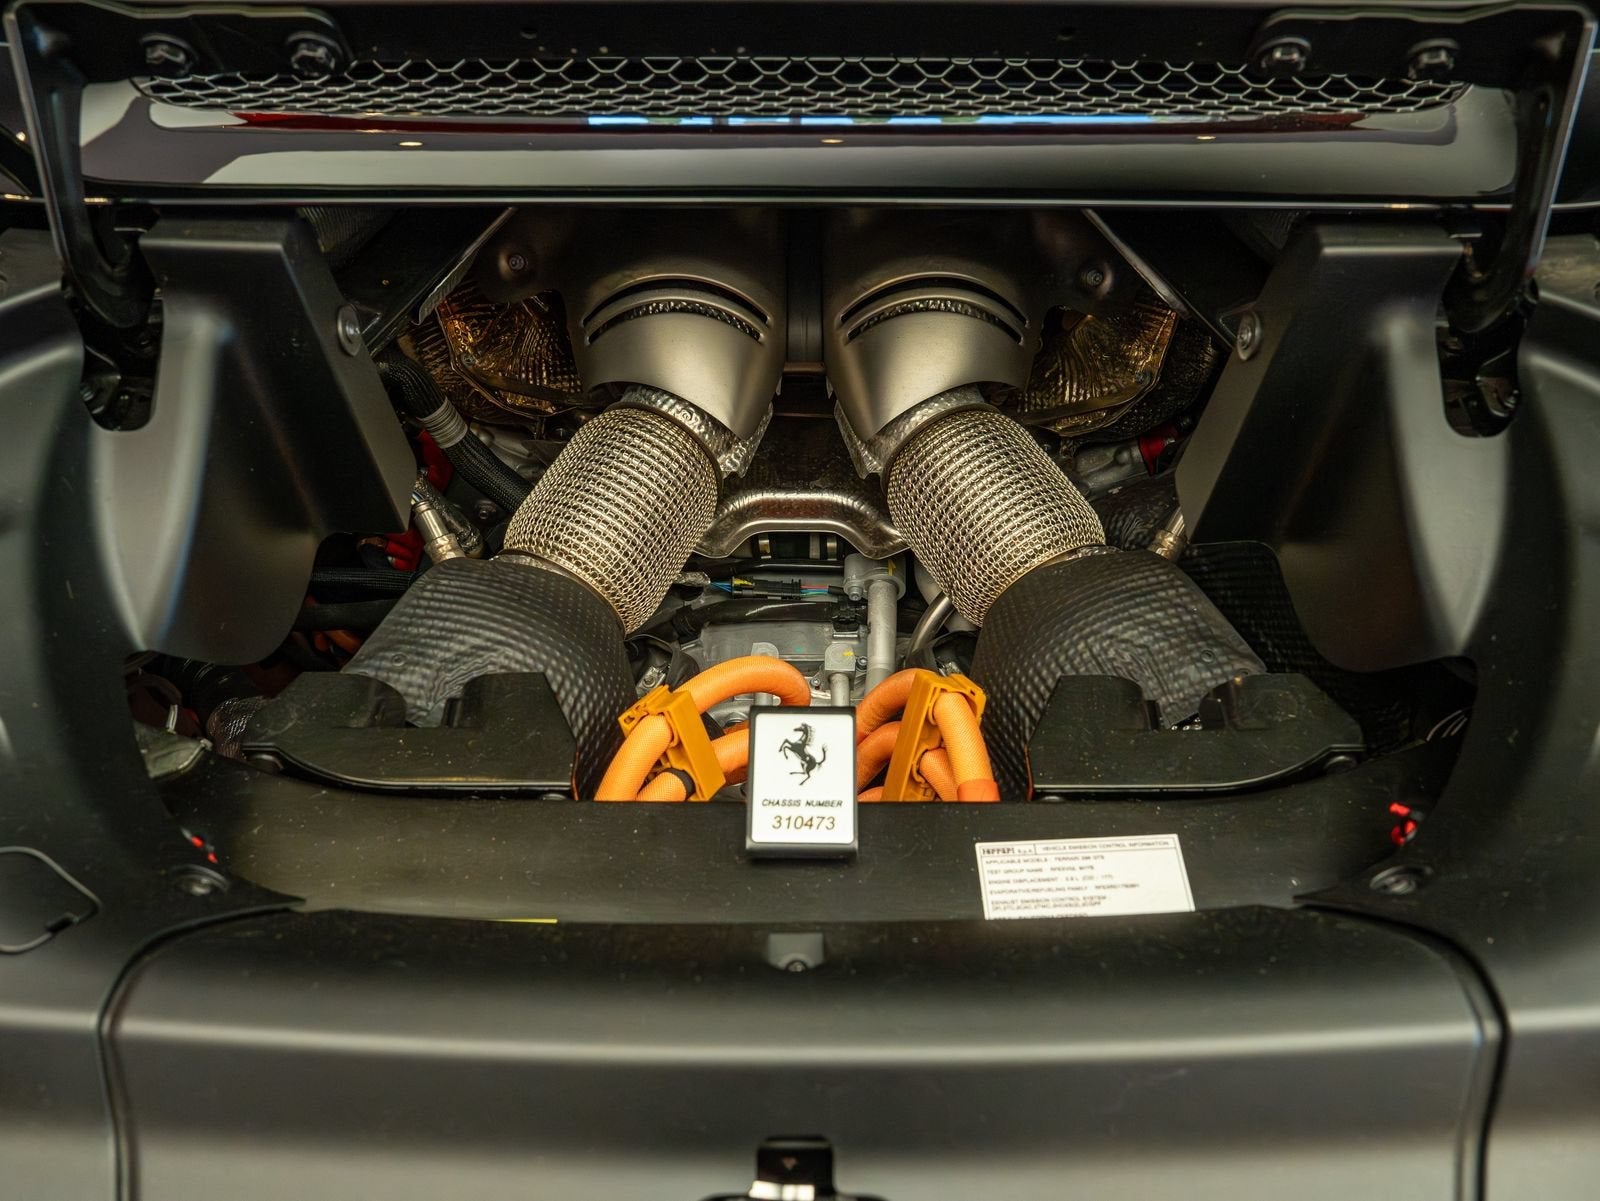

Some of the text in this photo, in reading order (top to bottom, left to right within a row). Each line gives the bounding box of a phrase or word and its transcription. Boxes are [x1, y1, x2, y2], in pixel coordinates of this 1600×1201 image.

[761, 799, 843, 808] CHASSIS NUMBER
[772, 815, 836, 830] 310473
